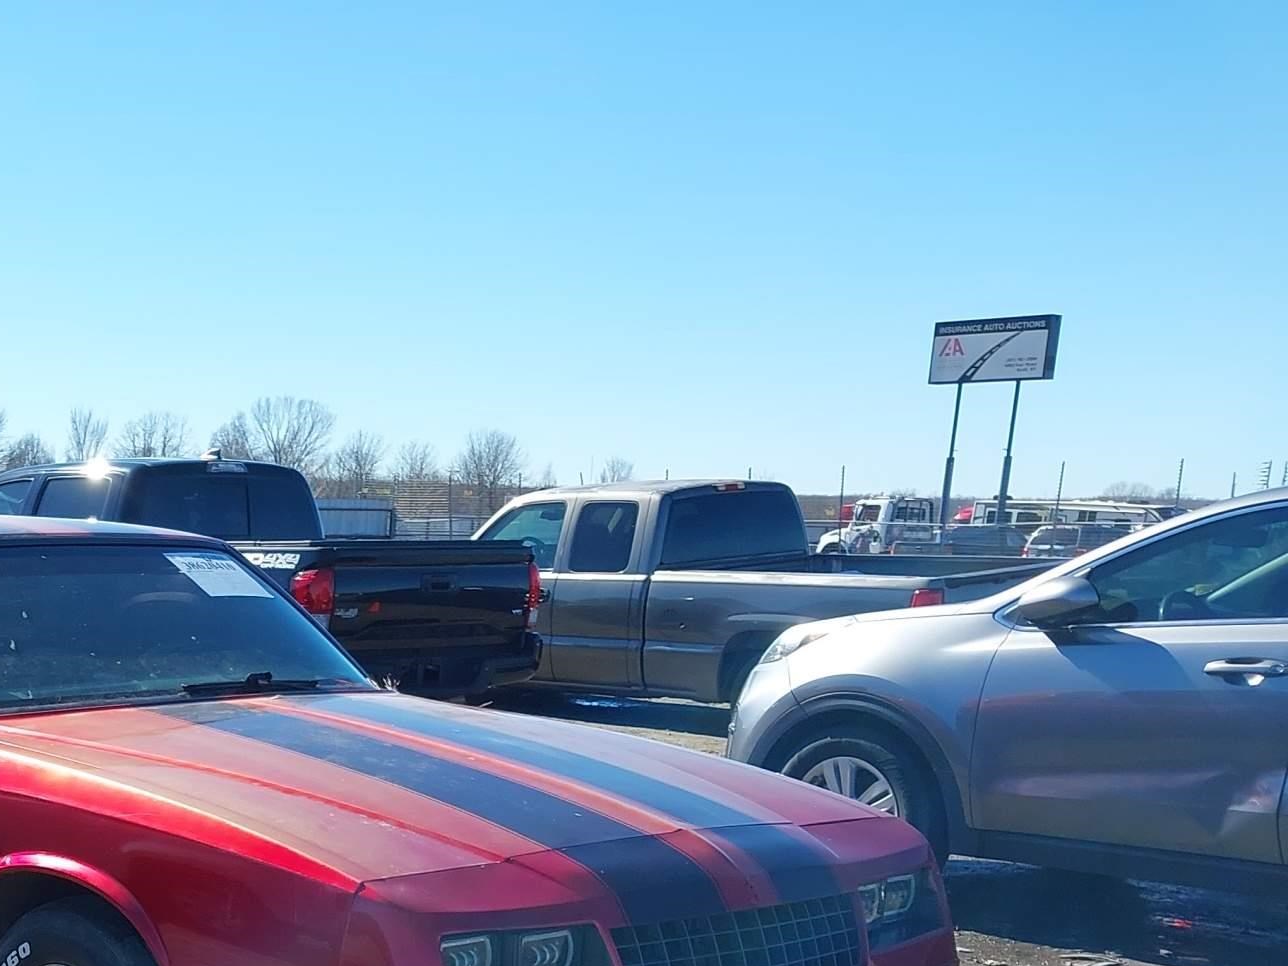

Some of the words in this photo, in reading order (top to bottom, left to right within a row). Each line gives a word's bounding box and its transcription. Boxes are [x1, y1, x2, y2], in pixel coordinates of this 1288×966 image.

[939, 325, 982, 335] INSURANCE
[983, 322, 1005, 331] AUTO
[1006, 320, 1046, 330] AUCTIONS
